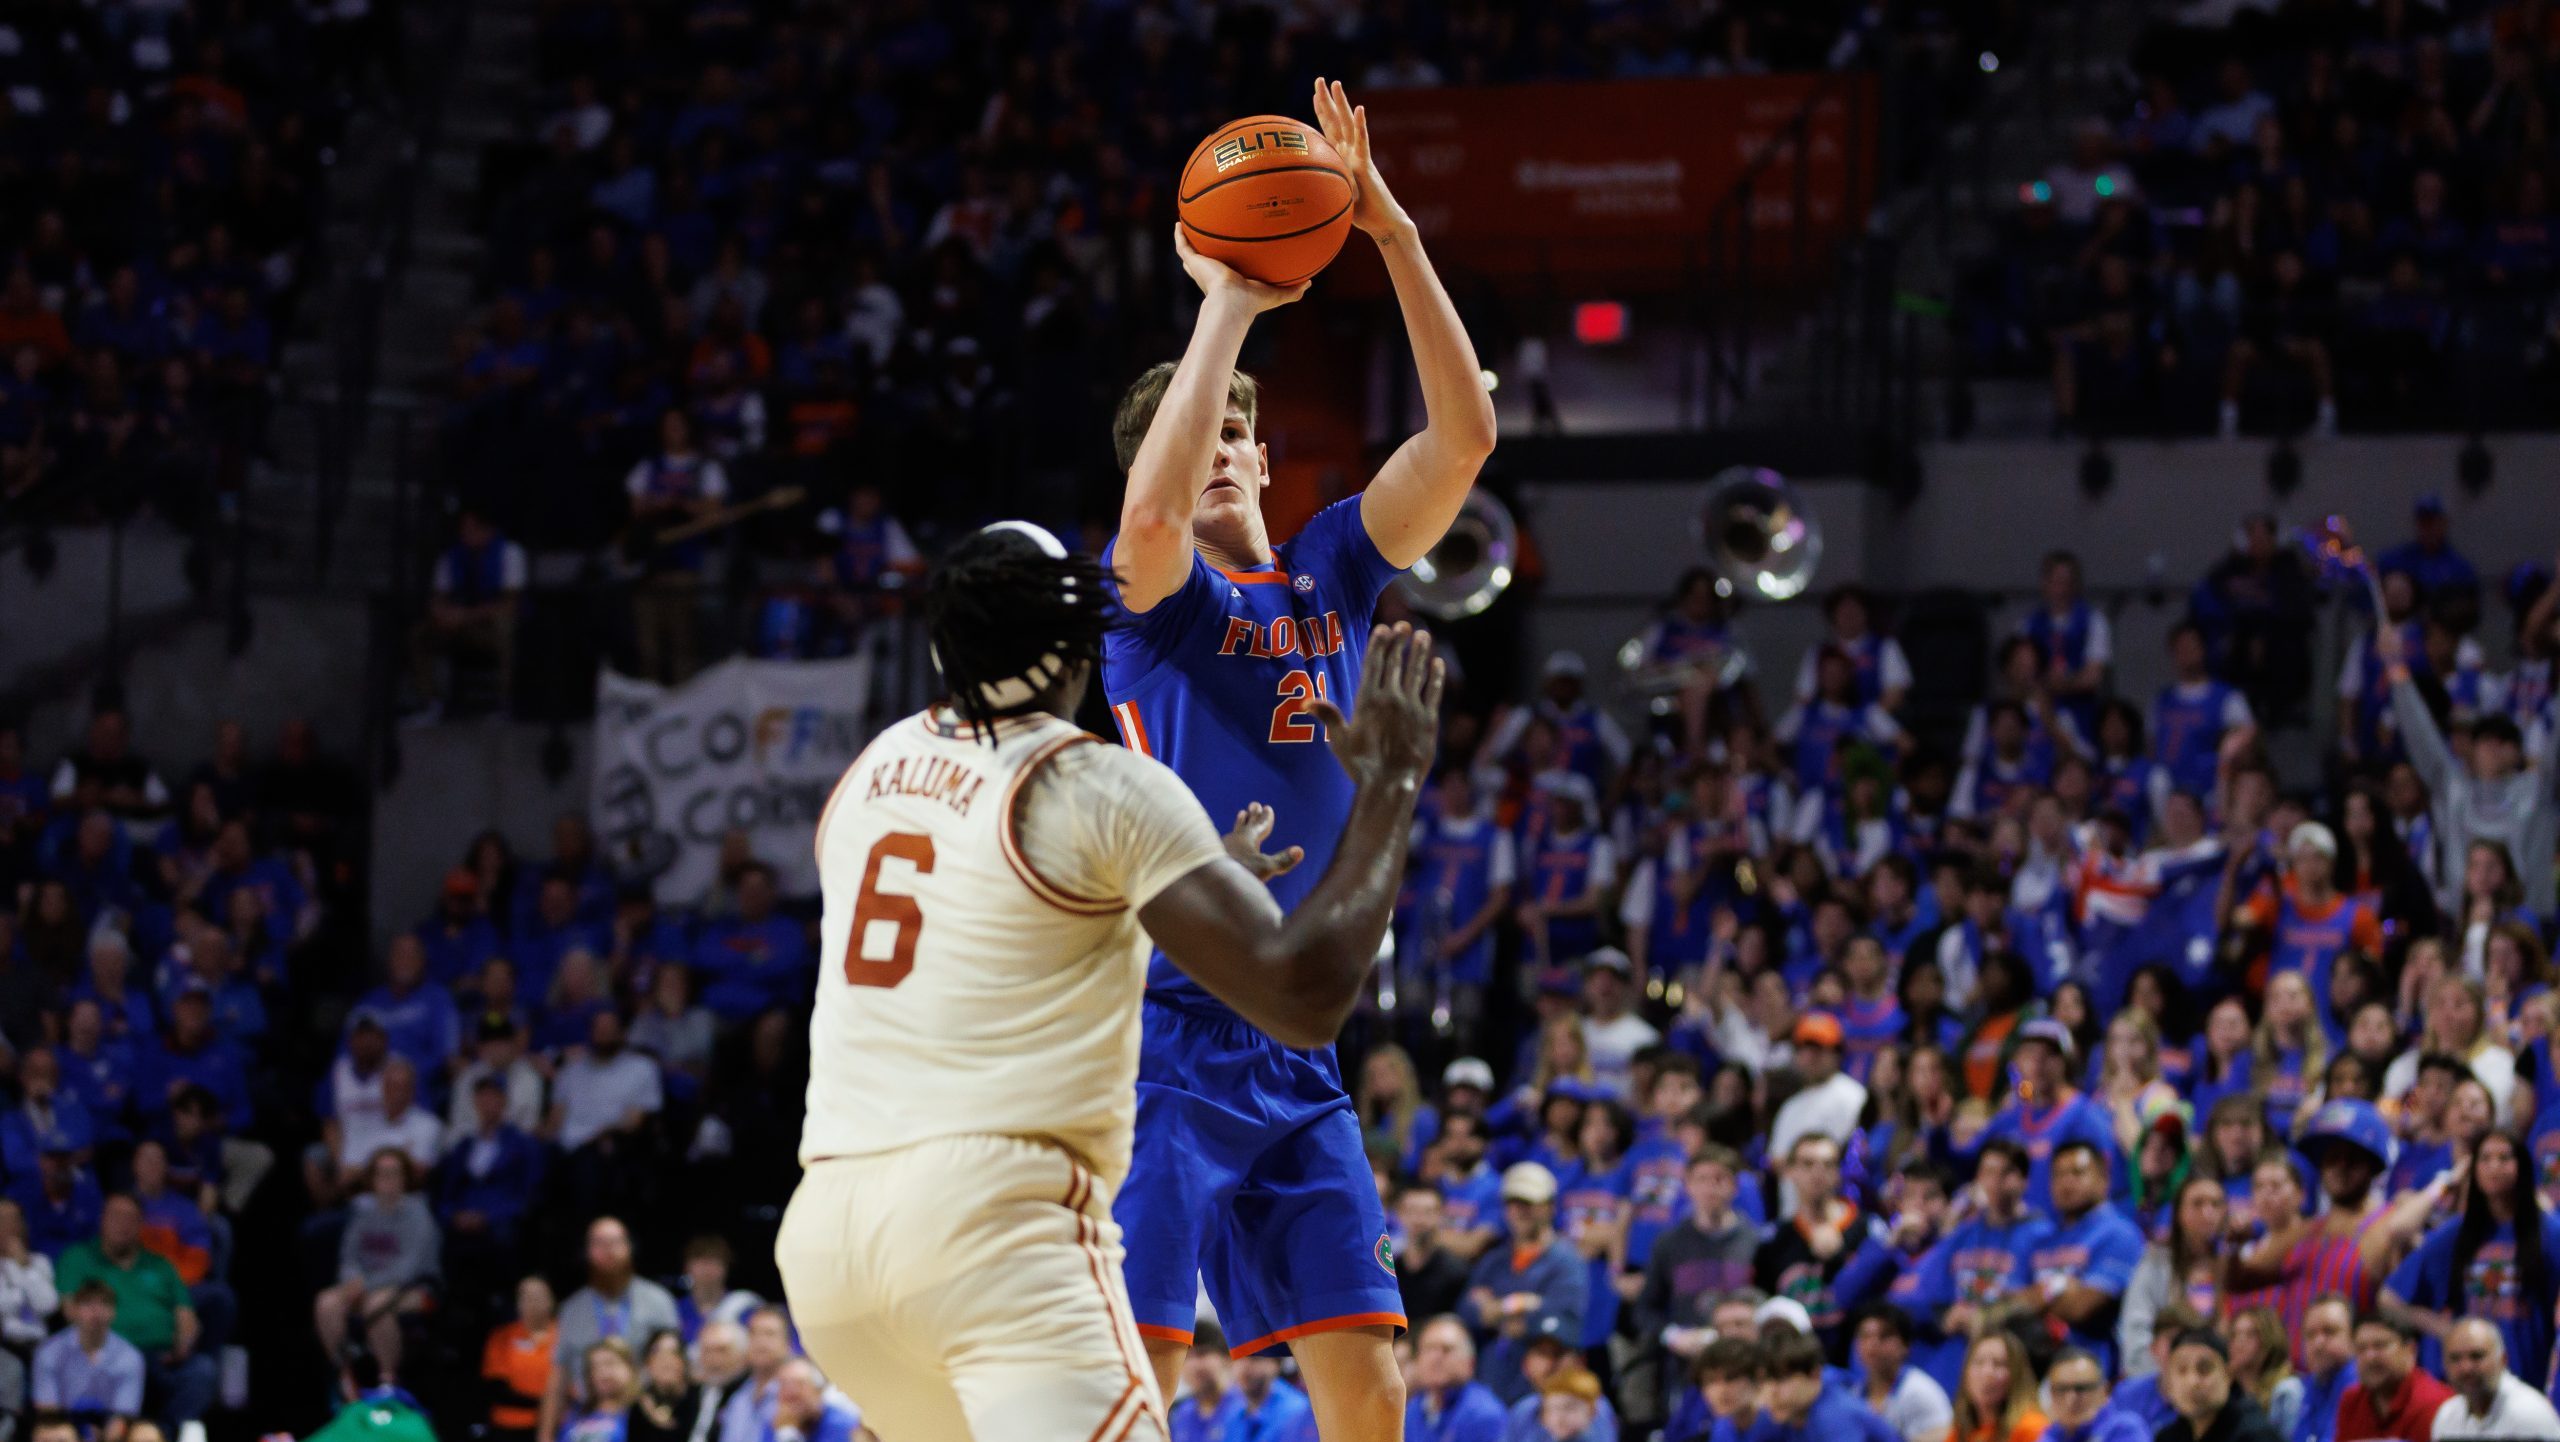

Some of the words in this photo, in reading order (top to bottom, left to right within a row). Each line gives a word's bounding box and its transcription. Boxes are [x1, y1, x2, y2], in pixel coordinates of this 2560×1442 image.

[1213, 131, 1309, 167] ELITE
[1217, 610, 1345, 662] FLOIDA
[865, 755, 986, 818] KALUMA
[843, 831, 936, 989] 6
